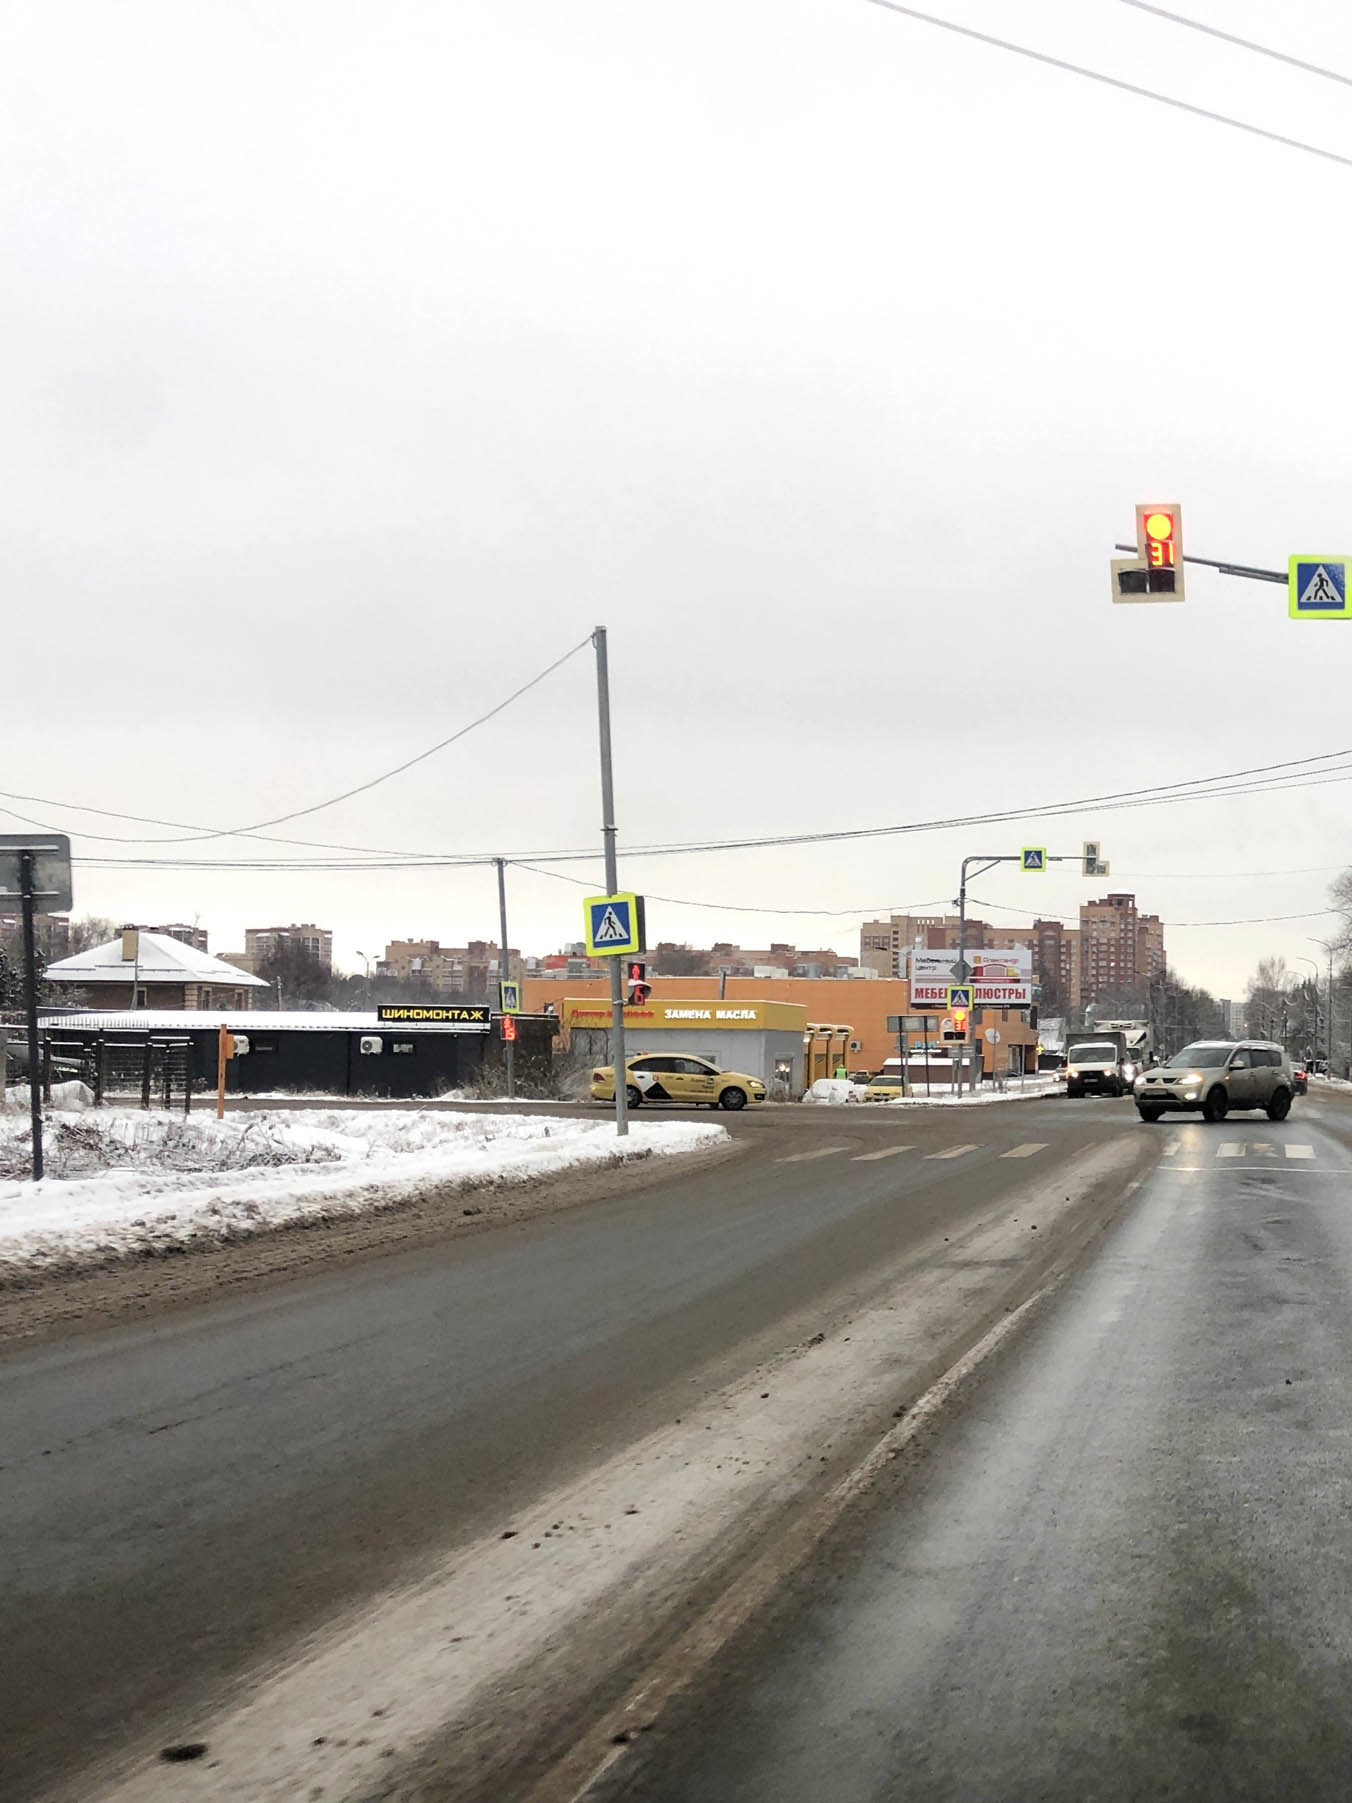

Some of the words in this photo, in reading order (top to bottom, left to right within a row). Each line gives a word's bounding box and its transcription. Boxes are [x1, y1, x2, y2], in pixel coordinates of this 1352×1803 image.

[1151, 542, 1175, 566] 31
[914, 988, 948, 999] МЕБЕЛ
[974, 988, 1026, 999] ЛЮСТРЫ
[382, 1008, 484, 1020] ШИНОМОНТАЖ
[664, 1009, 711, 1019] ЗАМЕНА
[716, 1010, 757, 1020] МАСЛА
